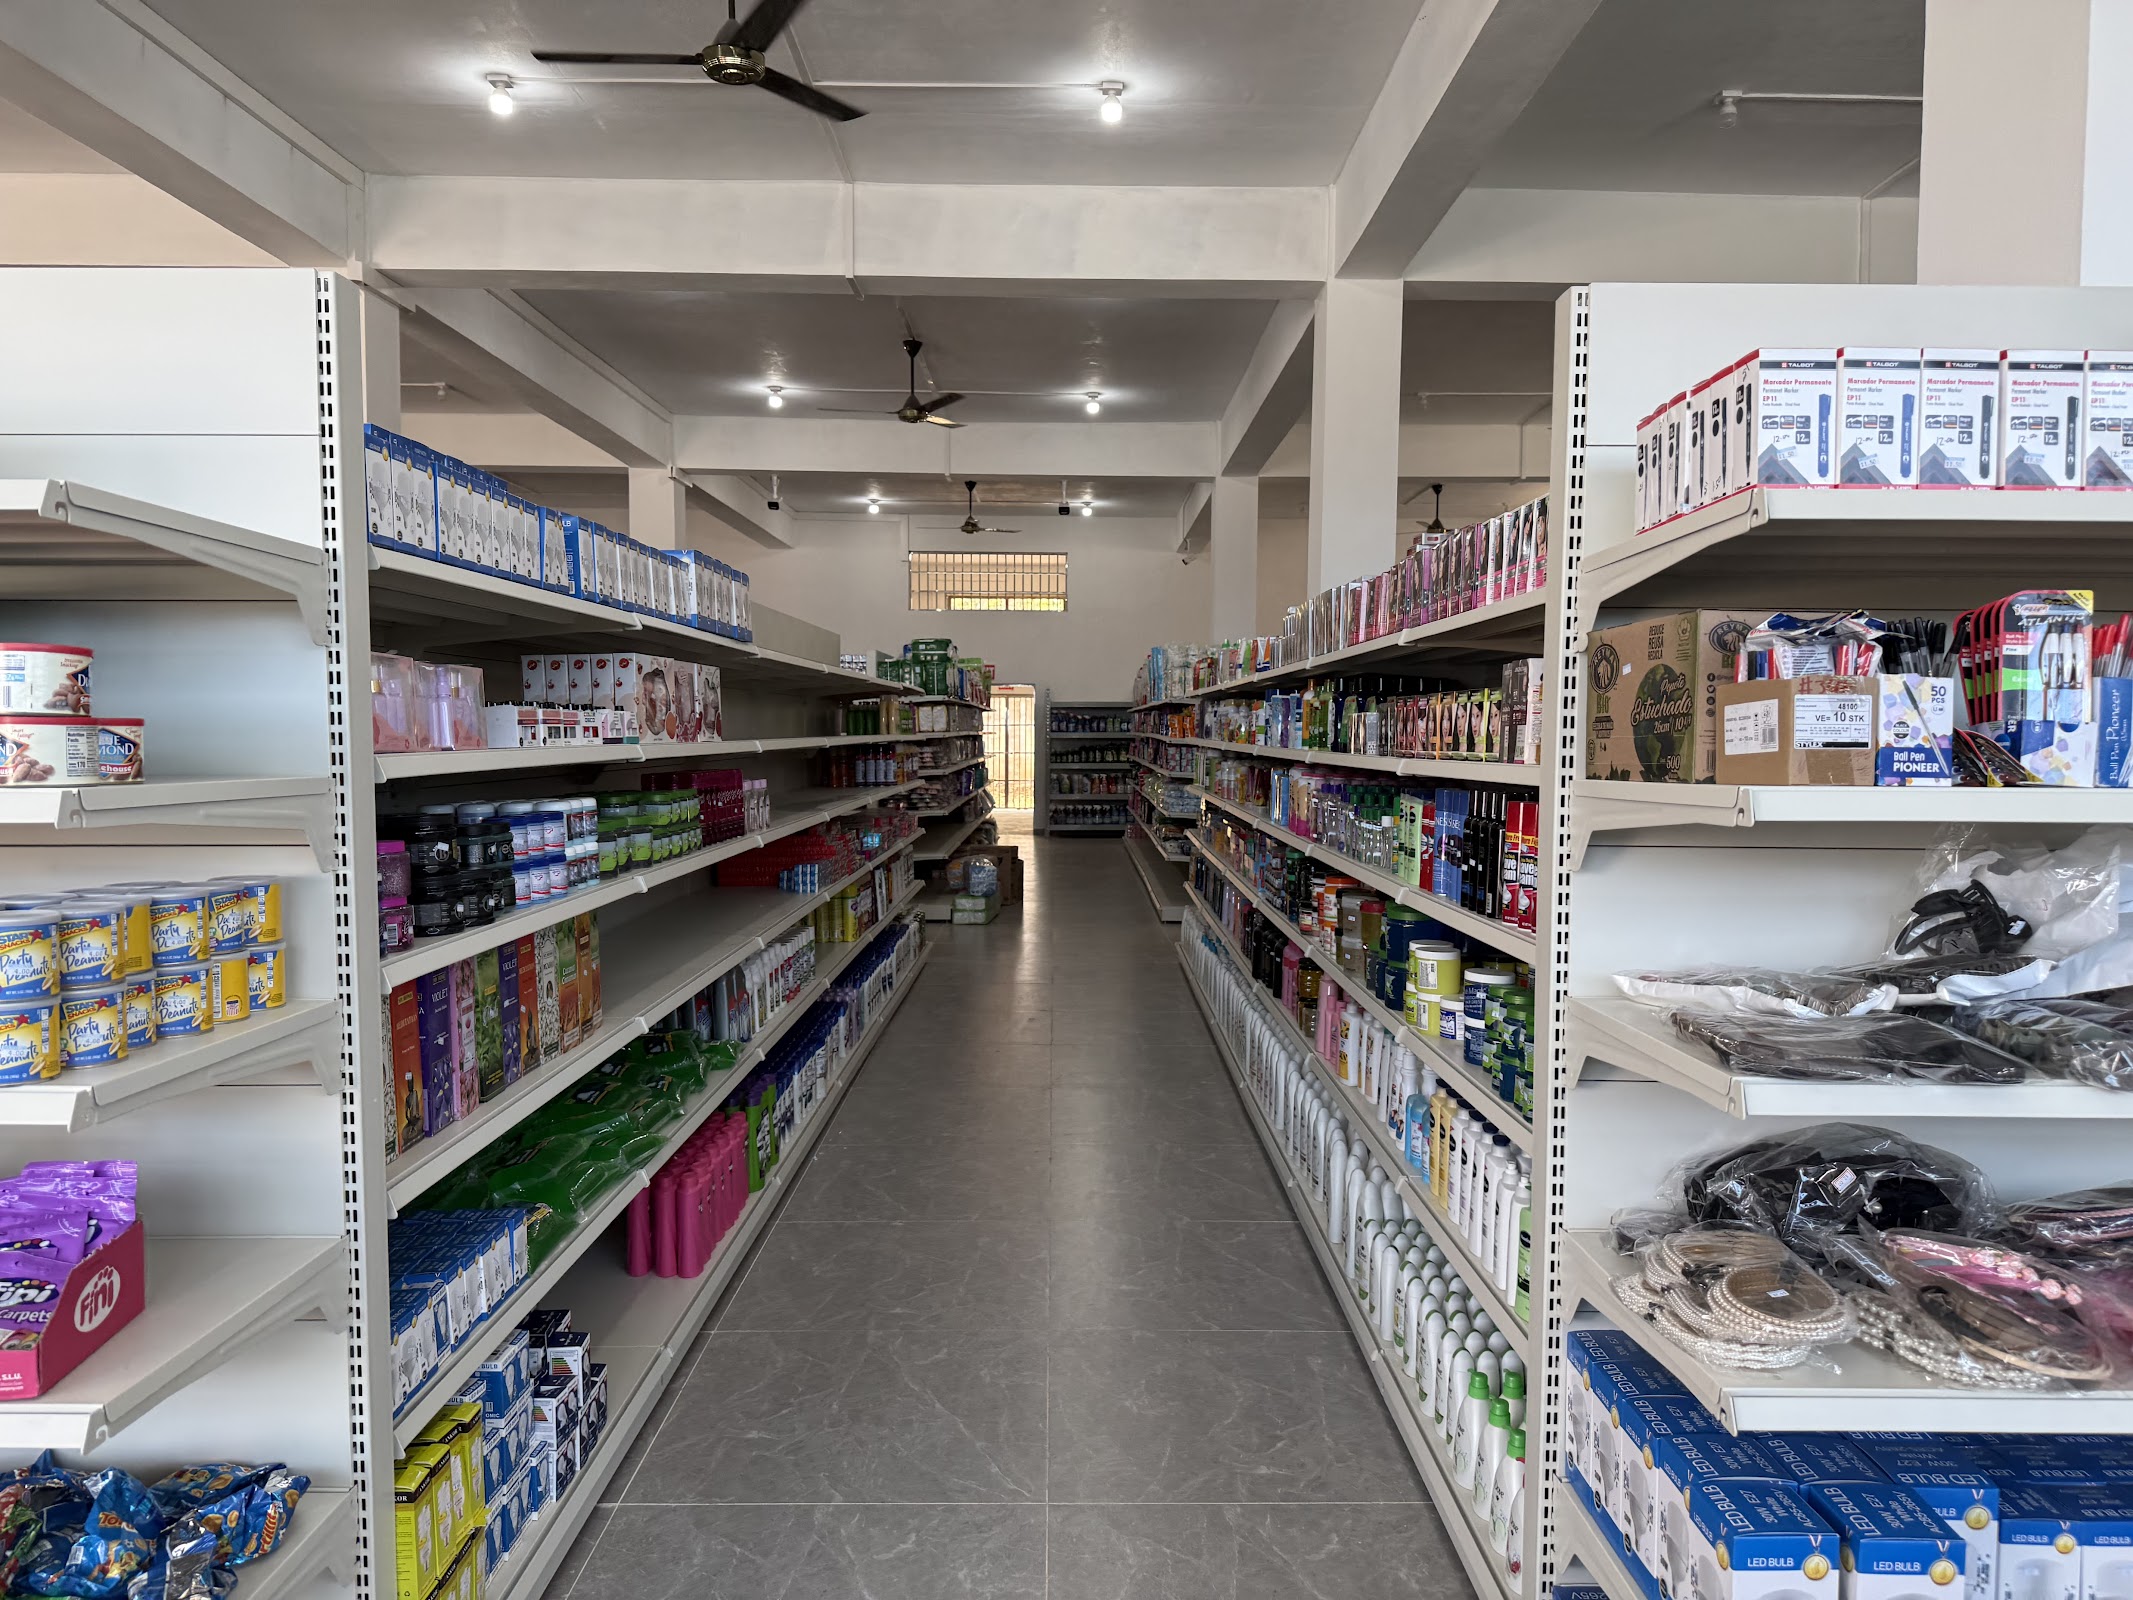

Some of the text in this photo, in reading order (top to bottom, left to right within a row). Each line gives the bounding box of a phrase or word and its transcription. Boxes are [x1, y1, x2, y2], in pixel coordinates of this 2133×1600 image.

[1716, 624, 1749, 636] REYMA
[1648, 636, 1664, 649] REUSA
[1931, 686, 1946, 697] 50
[1632, 690, 1692, 726] Estuchado
[1834, 711, 1846, 722] 10
[2105, 689, 2120, 741] Pioneer
[1666, 756, 1680, 769] 500
[1893, 752, 1925, 761] Ball Pen
[1893, 762, 1940, 773] PIONEER
[2109, 762, 2118, 780] Ball
[214, 896, 235, 906] STAR
[152, 921, 180, 940] Party
[0, 932, 29, 944] STAR
[0, 939, 31, 950] SNACKS
[431, 988, 448, 1002] VIOLET
[65, 1001, 95, 1014] STAR
[67, 1007, 97, 1020] SNACKS
[160, 998, 199, 1022] Peanuts
[66, 1017, 100, 1039] Party
[0, 1041, 39, 1066] eanuts
[80, 1268, 114, 1327] Fini
[0, 1310, 53, 1323] Carpets
[1577, 1332, 1610, 1362] LED BULB
[1602, 1364, 1640, 1398] LED BULB
[1666, 1404, 1683, 1417] E27
[1634, 1400, 1673, 1436] LED BULB
[1672, 1437, 1703, 1459] BULB
[1706, 1441, 1726, 1453] E27
[1803, 1444, 1824, 1456] E27
[1768, 1440, 1820, 1481] LED BULB
[1692, 1460, 1719, 1478] LED
[1897, 1473, 1989, 1485] LED BULB
[1702, 1485, 1755, 1532] LED BULB
[1739, 1489, 1778, 1524] 30W E27
[1765, 1496, 1790, 1517] White
[1824, 1487, 1882, 1536] LED BULB
[1861, 1492, 1905, 1529] 30W E27
[1888, 1500, 1914, 1522] White
[2011, 1534, 2049, 1543] LED BULB
[2094, 1536, 2132, 1544] LED BULB
[1747, 1558, 1794, 1567] LED BULB
[1873, 1562, 1920, 1572] LED BULB
